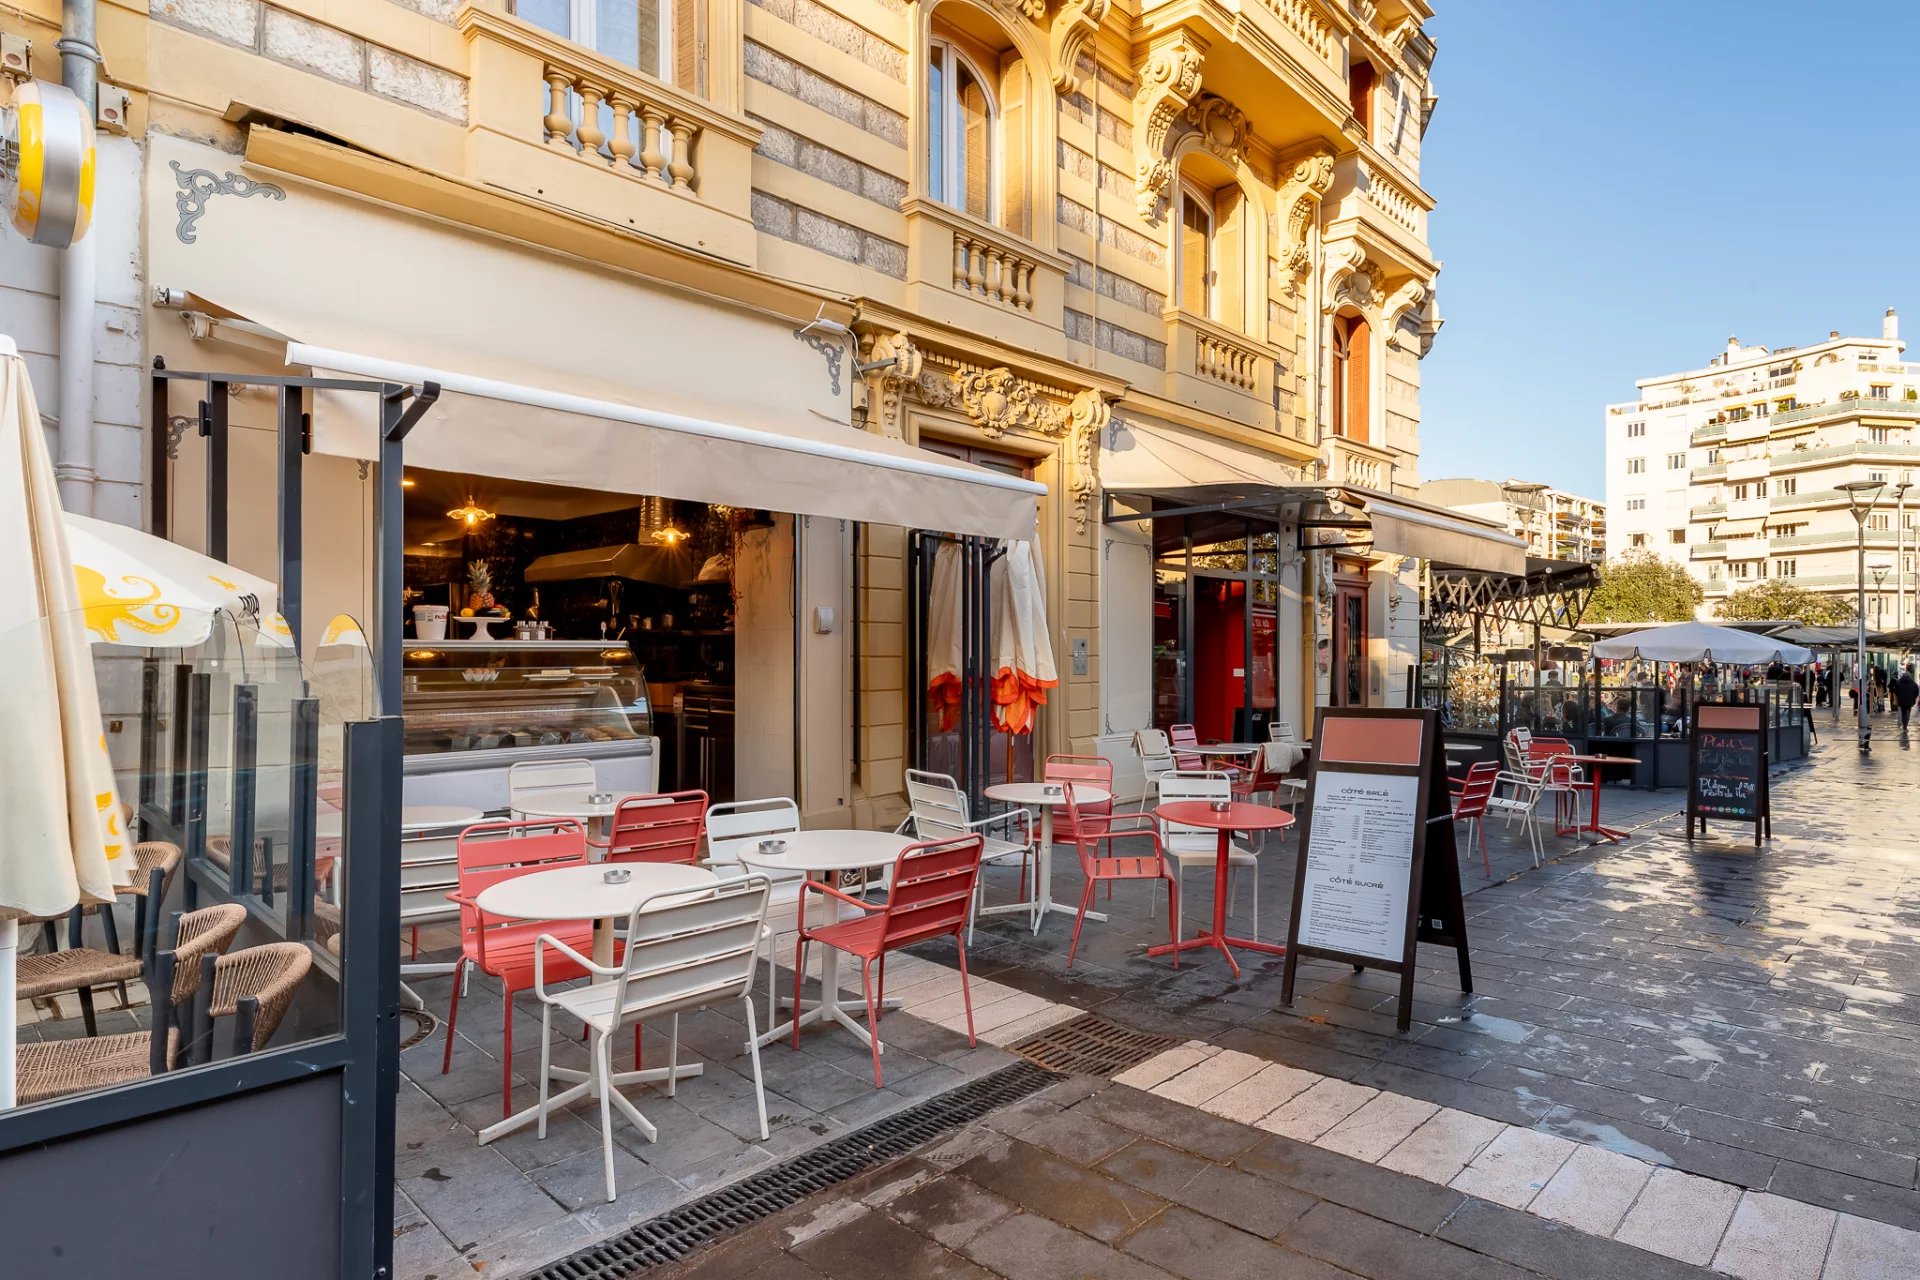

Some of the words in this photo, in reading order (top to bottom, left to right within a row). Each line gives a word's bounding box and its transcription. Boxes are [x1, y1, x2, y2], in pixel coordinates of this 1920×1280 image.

[1340, 787, 1365, 795] CÔTÉ
[1329, 876, 1353, 885] CÔTÉ
[1354, 878, 1384, 889] SUCRÉ
